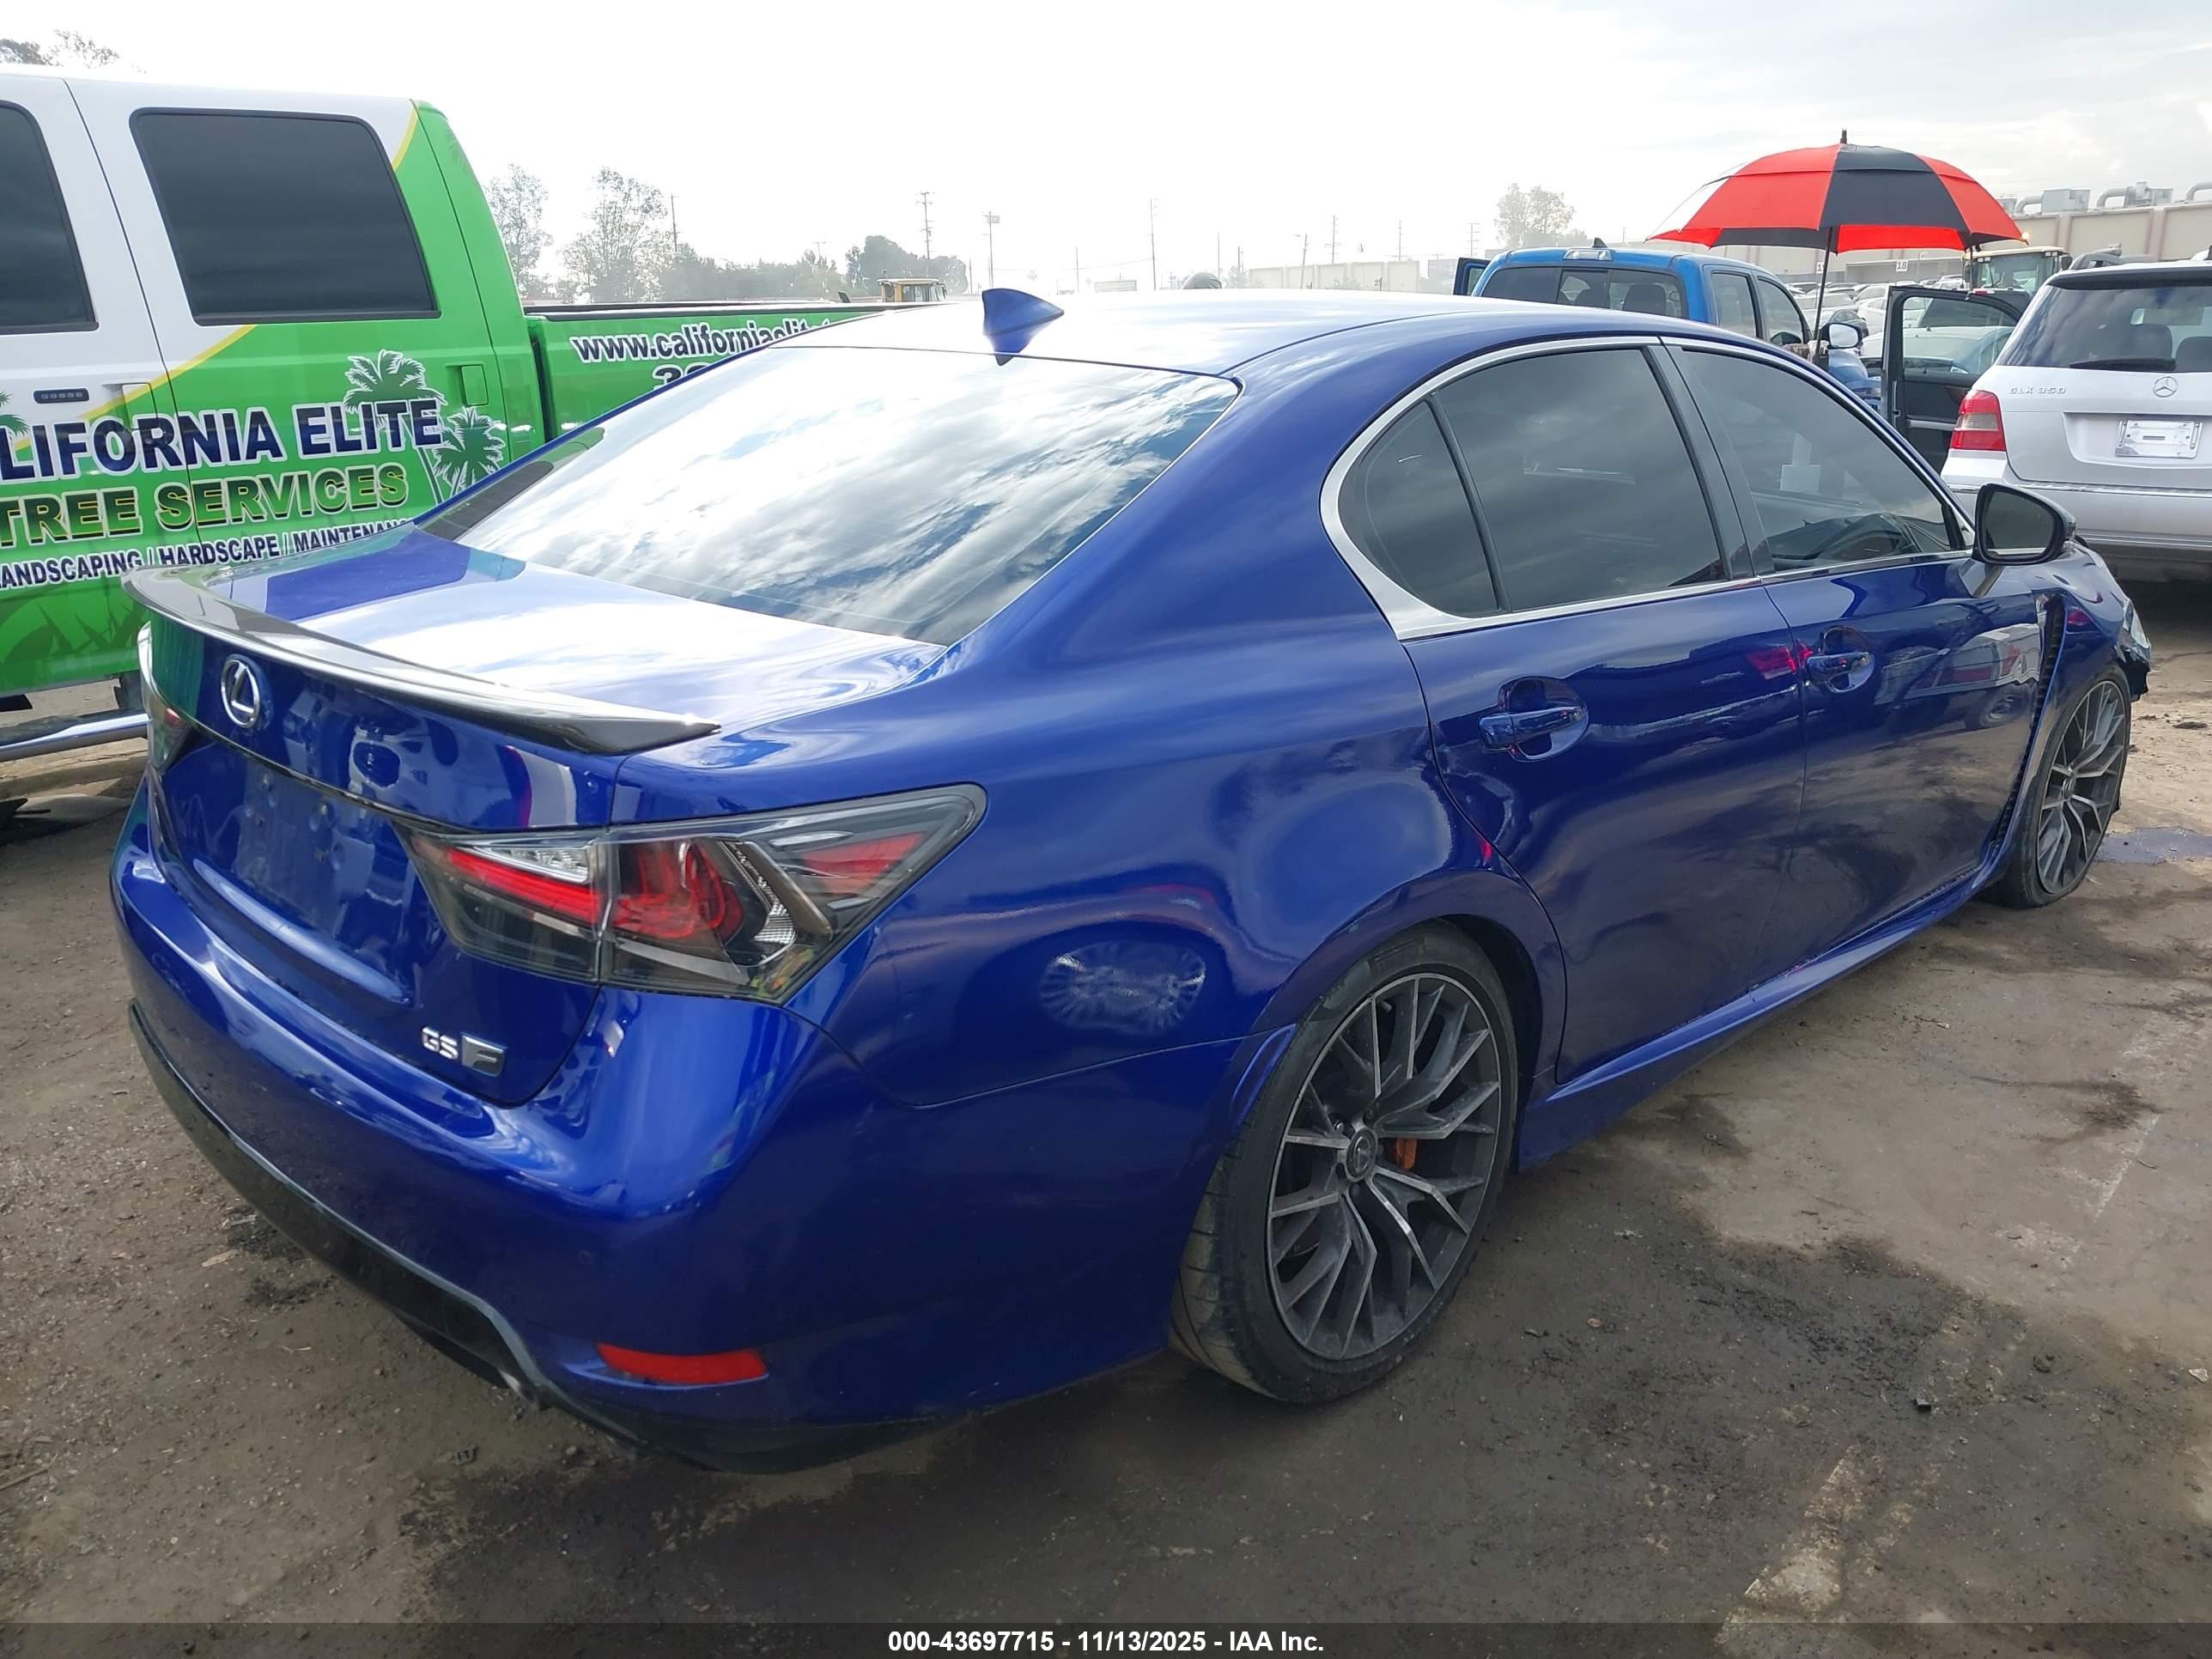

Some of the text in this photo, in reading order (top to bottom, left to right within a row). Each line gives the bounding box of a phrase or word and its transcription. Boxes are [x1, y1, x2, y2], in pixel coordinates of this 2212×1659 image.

[1896, 261, 1907, 270] 18
[2009, 386, 2066, 395] GLK 350
[295, 400, 441, 455] ELITE
[0, 465, 408, 547] TREE SERVICES
[0, 550, 143, 589] ANDSCAPING
[158, 535, 280, 565] HARDSCAPE
[292, 518, 409, 552] MAINTENA
[421, 1025, 459, 1060] GS
